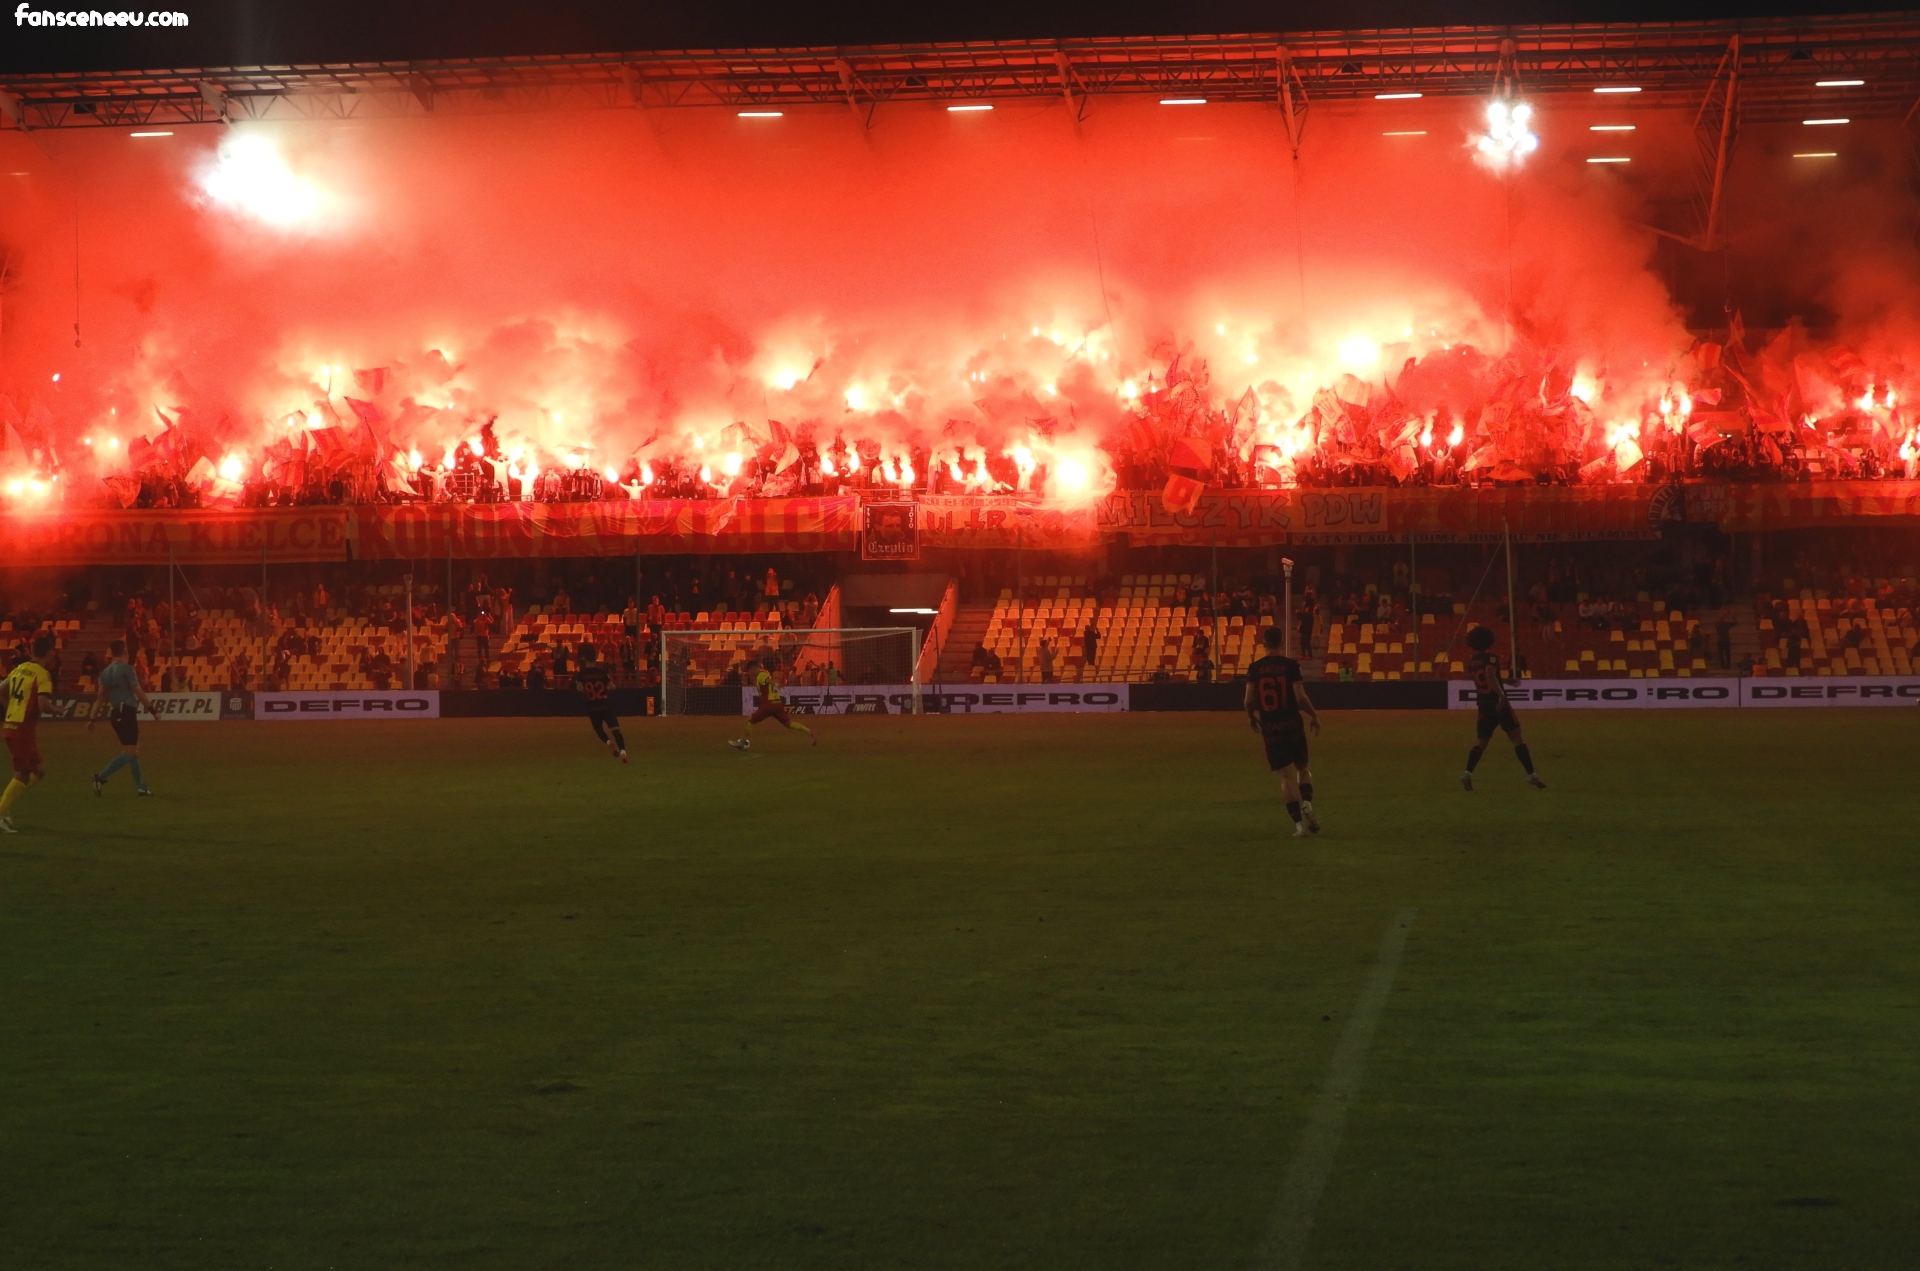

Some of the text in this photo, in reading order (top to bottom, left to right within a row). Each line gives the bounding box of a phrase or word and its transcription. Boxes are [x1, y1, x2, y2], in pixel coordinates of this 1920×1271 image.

[1301, 491, 1383, 526] PDW
[188, 517, 346, 551] KIELCE
[12, 677, 24, 706] 14
[264, 699, 430, 713] DEFRO
[940, 693, 1118, 706] DEFRO
[1259, 676, 1288, 712] 61
